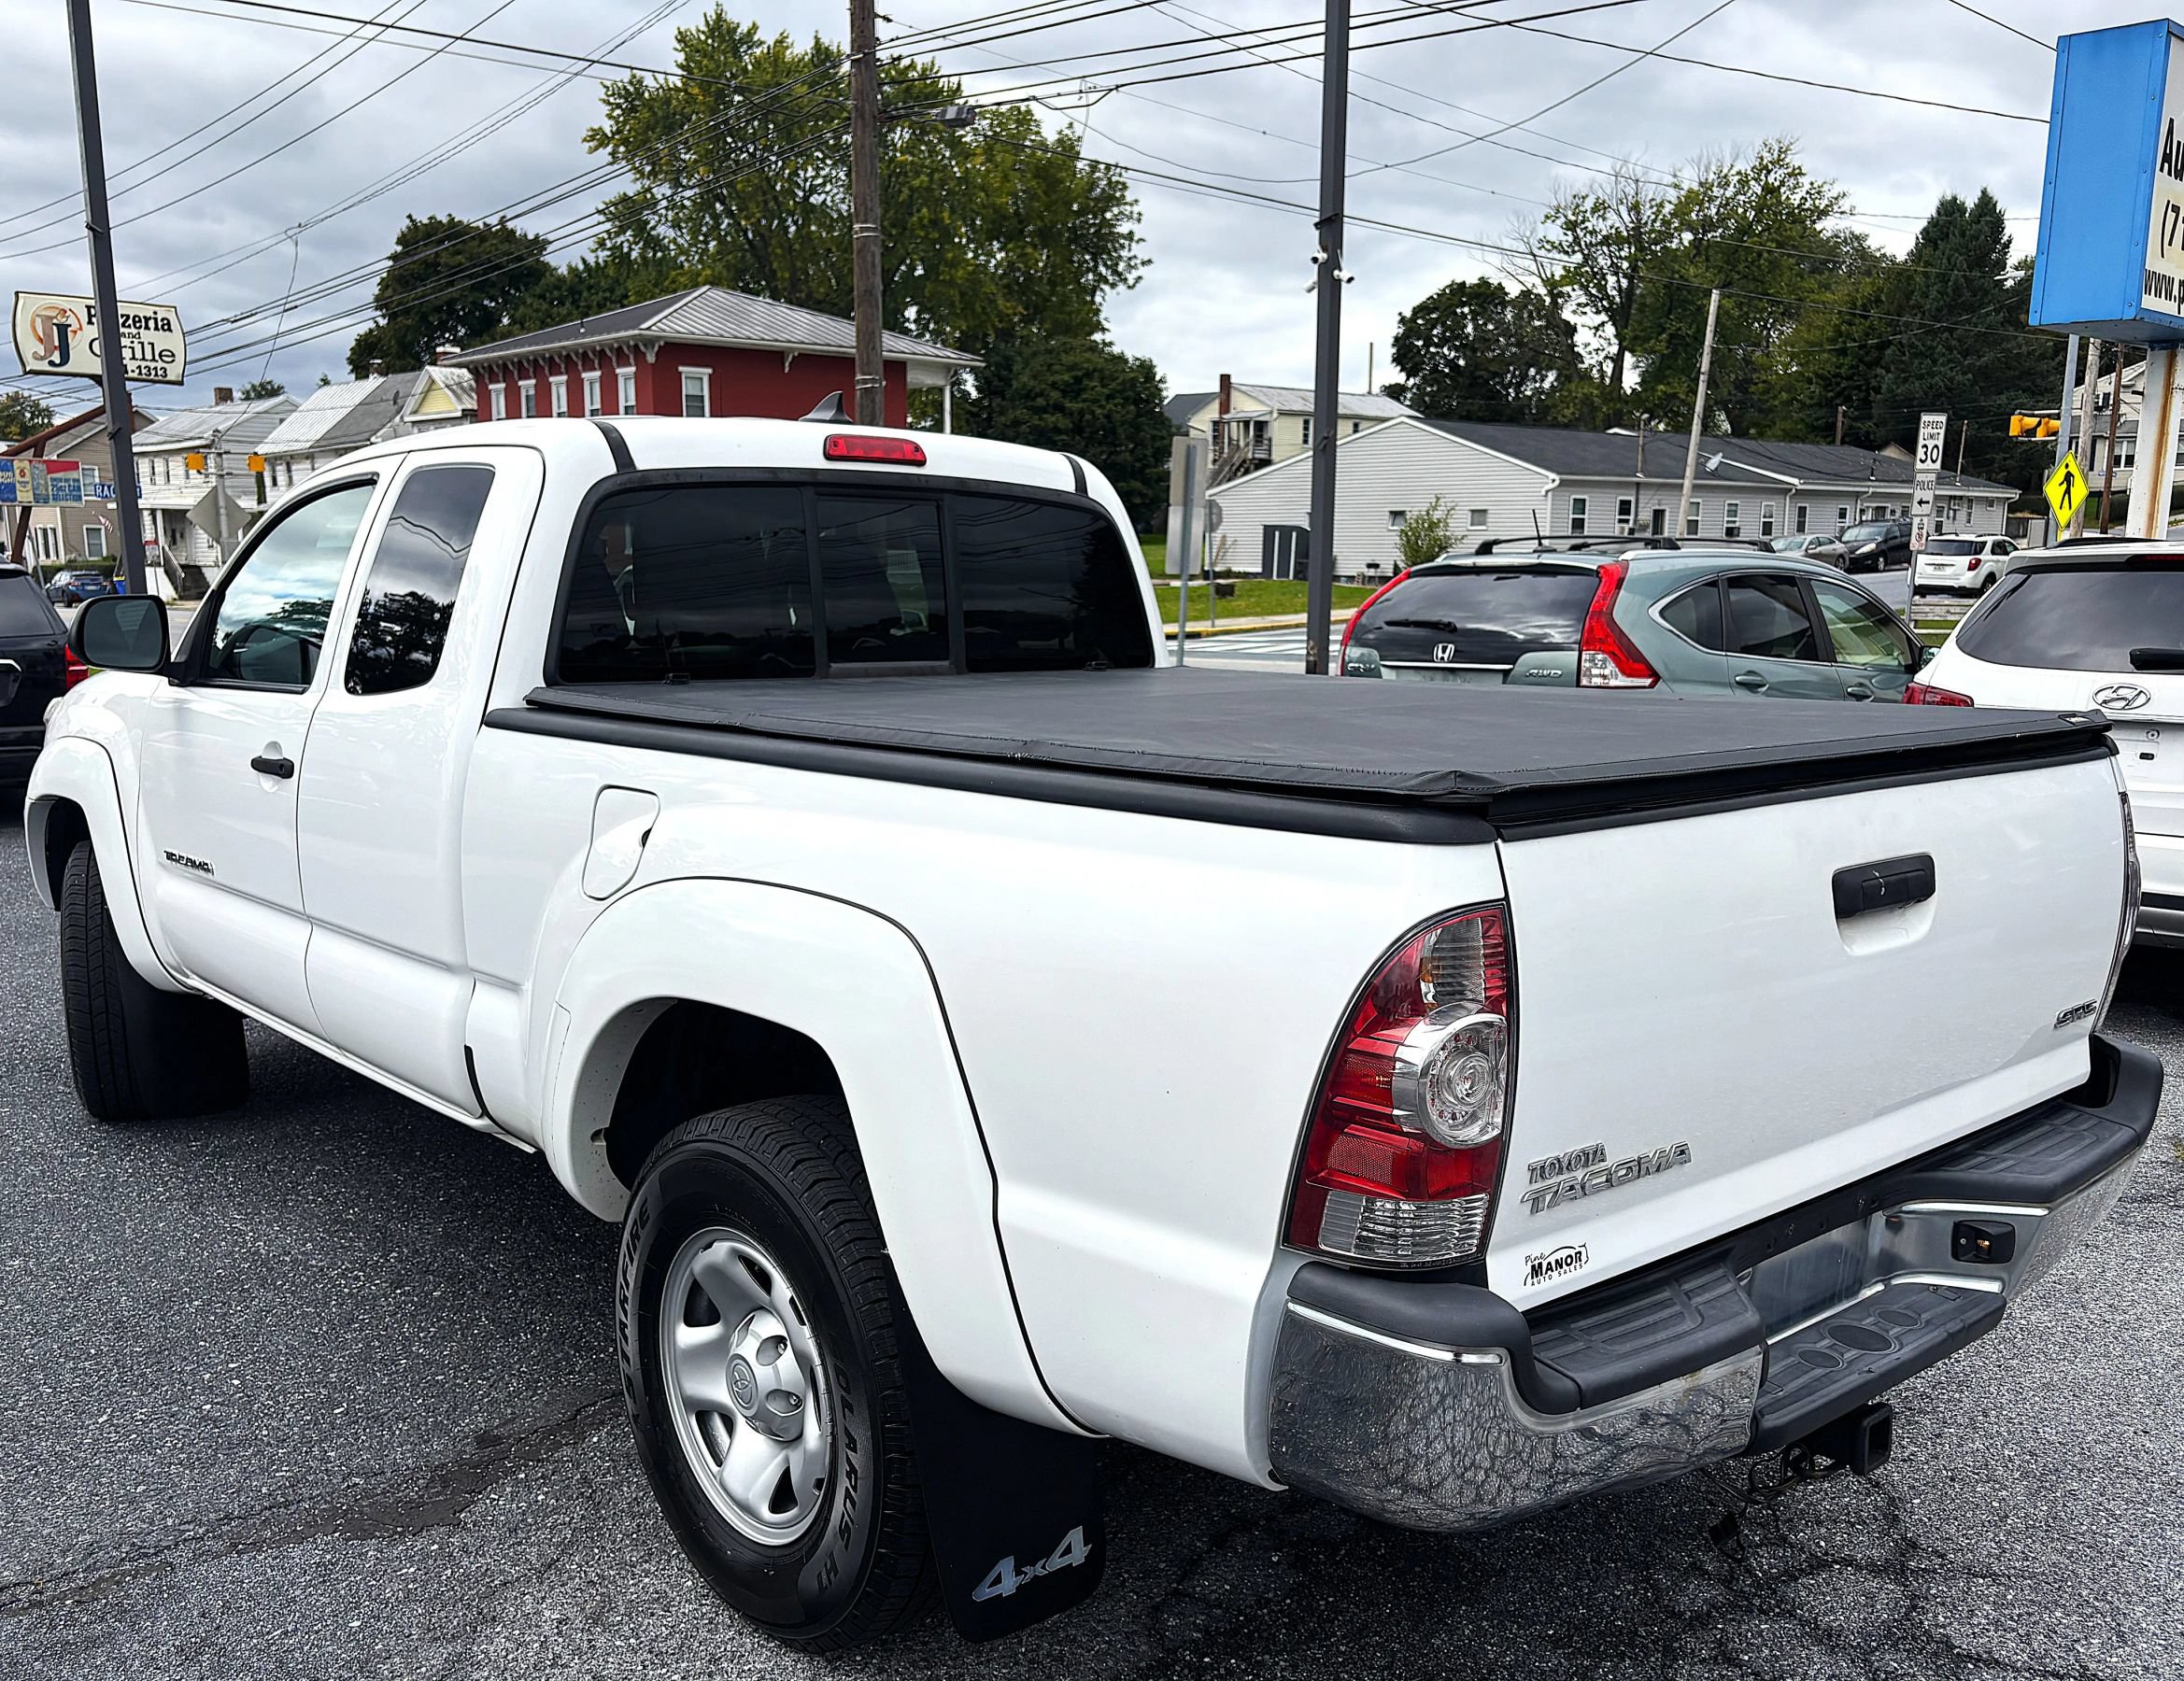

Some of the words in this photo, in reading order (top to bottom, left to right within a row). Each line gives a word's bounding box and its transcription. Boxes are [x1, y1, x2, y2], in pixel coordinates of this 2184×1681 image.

[2159, 117, 2184, 182] Au
[85, 305, 173, 333] Pzeria
[121, 331, 141, 340] and
[1922, 419, 1944, 431] SPEED
[1922, 431, 1940, 442] LIMIT
[1919, 444, 1940, 464] 30
[1915, 479, 1935, 491] POLICE
[1528, 1142, 1608, 1184] TOYOTA
[1520, 1141, 1693, 1215] TACOMA
[1525, 1252, 1546, 1266] Pine
[1531, 1250, 1582, 1280] MANOR
[1531, 1274, 1553, 1287] AUTO
[1557, 1263, 1583, 1278] SALES
[618, 1196, 651, 1406] STARFIRE
[971, 1525, 1093, 1603] 4x4
